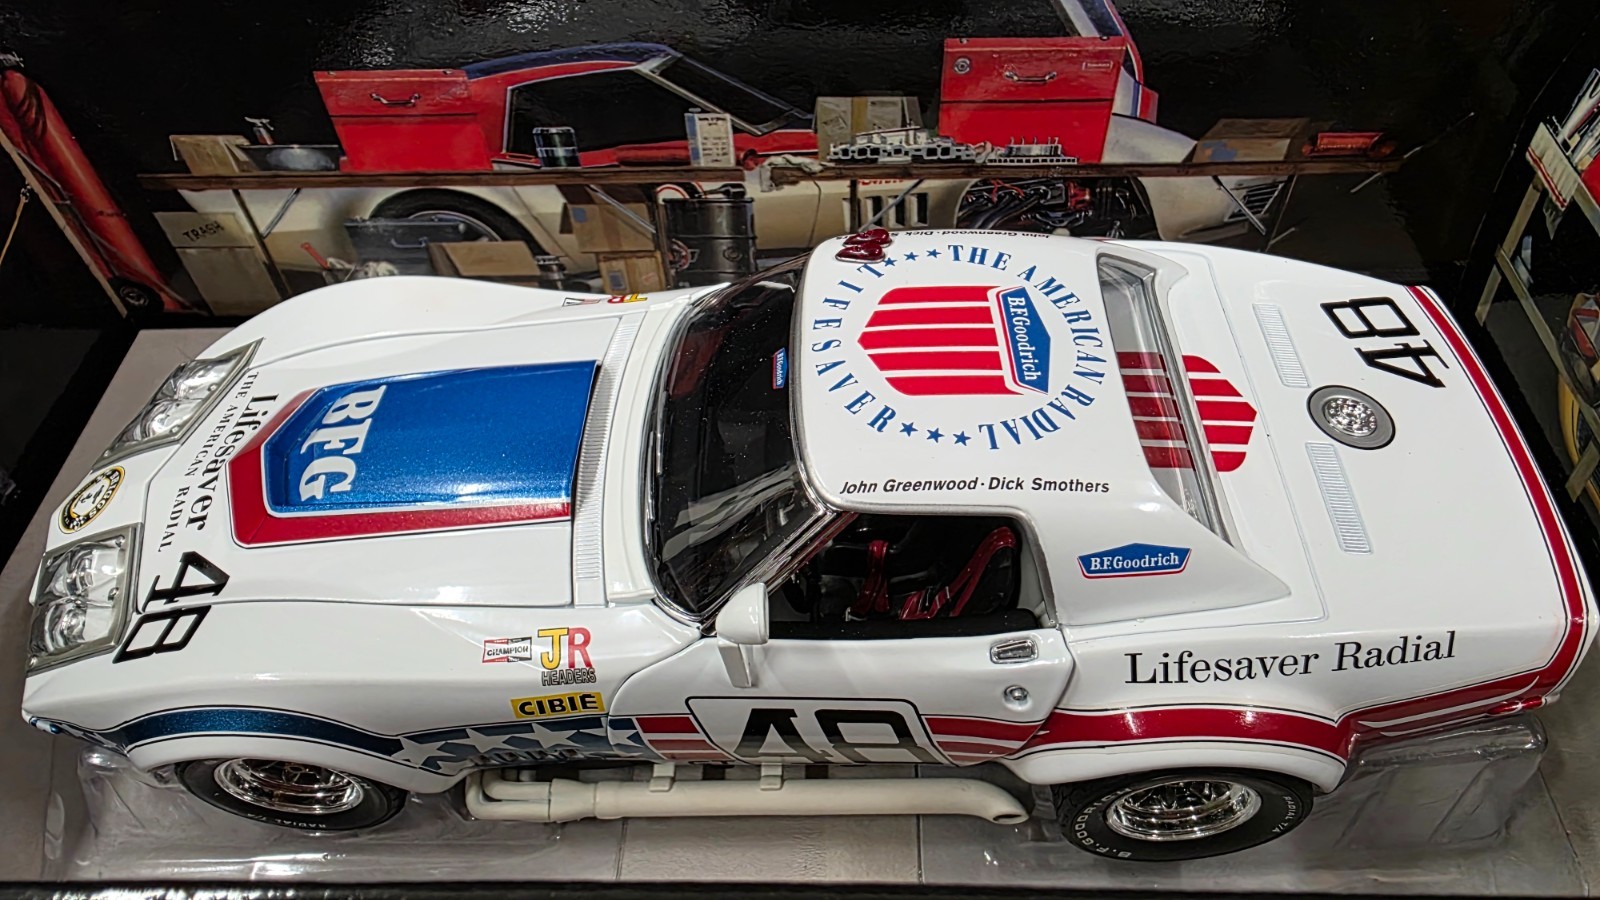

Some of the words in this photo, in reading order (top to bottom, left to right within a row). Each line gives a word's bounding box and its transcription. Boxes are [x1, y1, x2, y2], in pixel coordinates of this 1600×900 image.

[182, 221, 224, 242] TRASH
[948, 244, 1012, 272] THE
[811, 263, 898, 434] LIFESAVER
[1017, 265, 1108, 385] AMERICAN
[1320, 296, 1450, 388] 48
[239, 371, 259, 399] THE
[184, 404, 239, 477] AMERICAN
[299, 385, 387, 501] BFG
[978, 384, 1095, 451] RADIAL
[185, 393, 280, 531] Lifesaver
[840, 481, 878, 495] John
[882, 477, 979, 493] Greenwood
[988, 476, 1025, 491] Dick
[1031, 477, 1110, 493] Smothers
[157, 485, 190, 552] RADIAL
[112, 551, 231, 664] 48
[486, 646, 530, 657] CHAMPION
[537, 627, 593, 670] JR
[541, 668, 597, 687] HEADERS
[1124, 650, 1320, 684] Lifesaver
[1331, 630, 1457, 673] Radial
[1282, 795, 1297, 820] RADIAL
